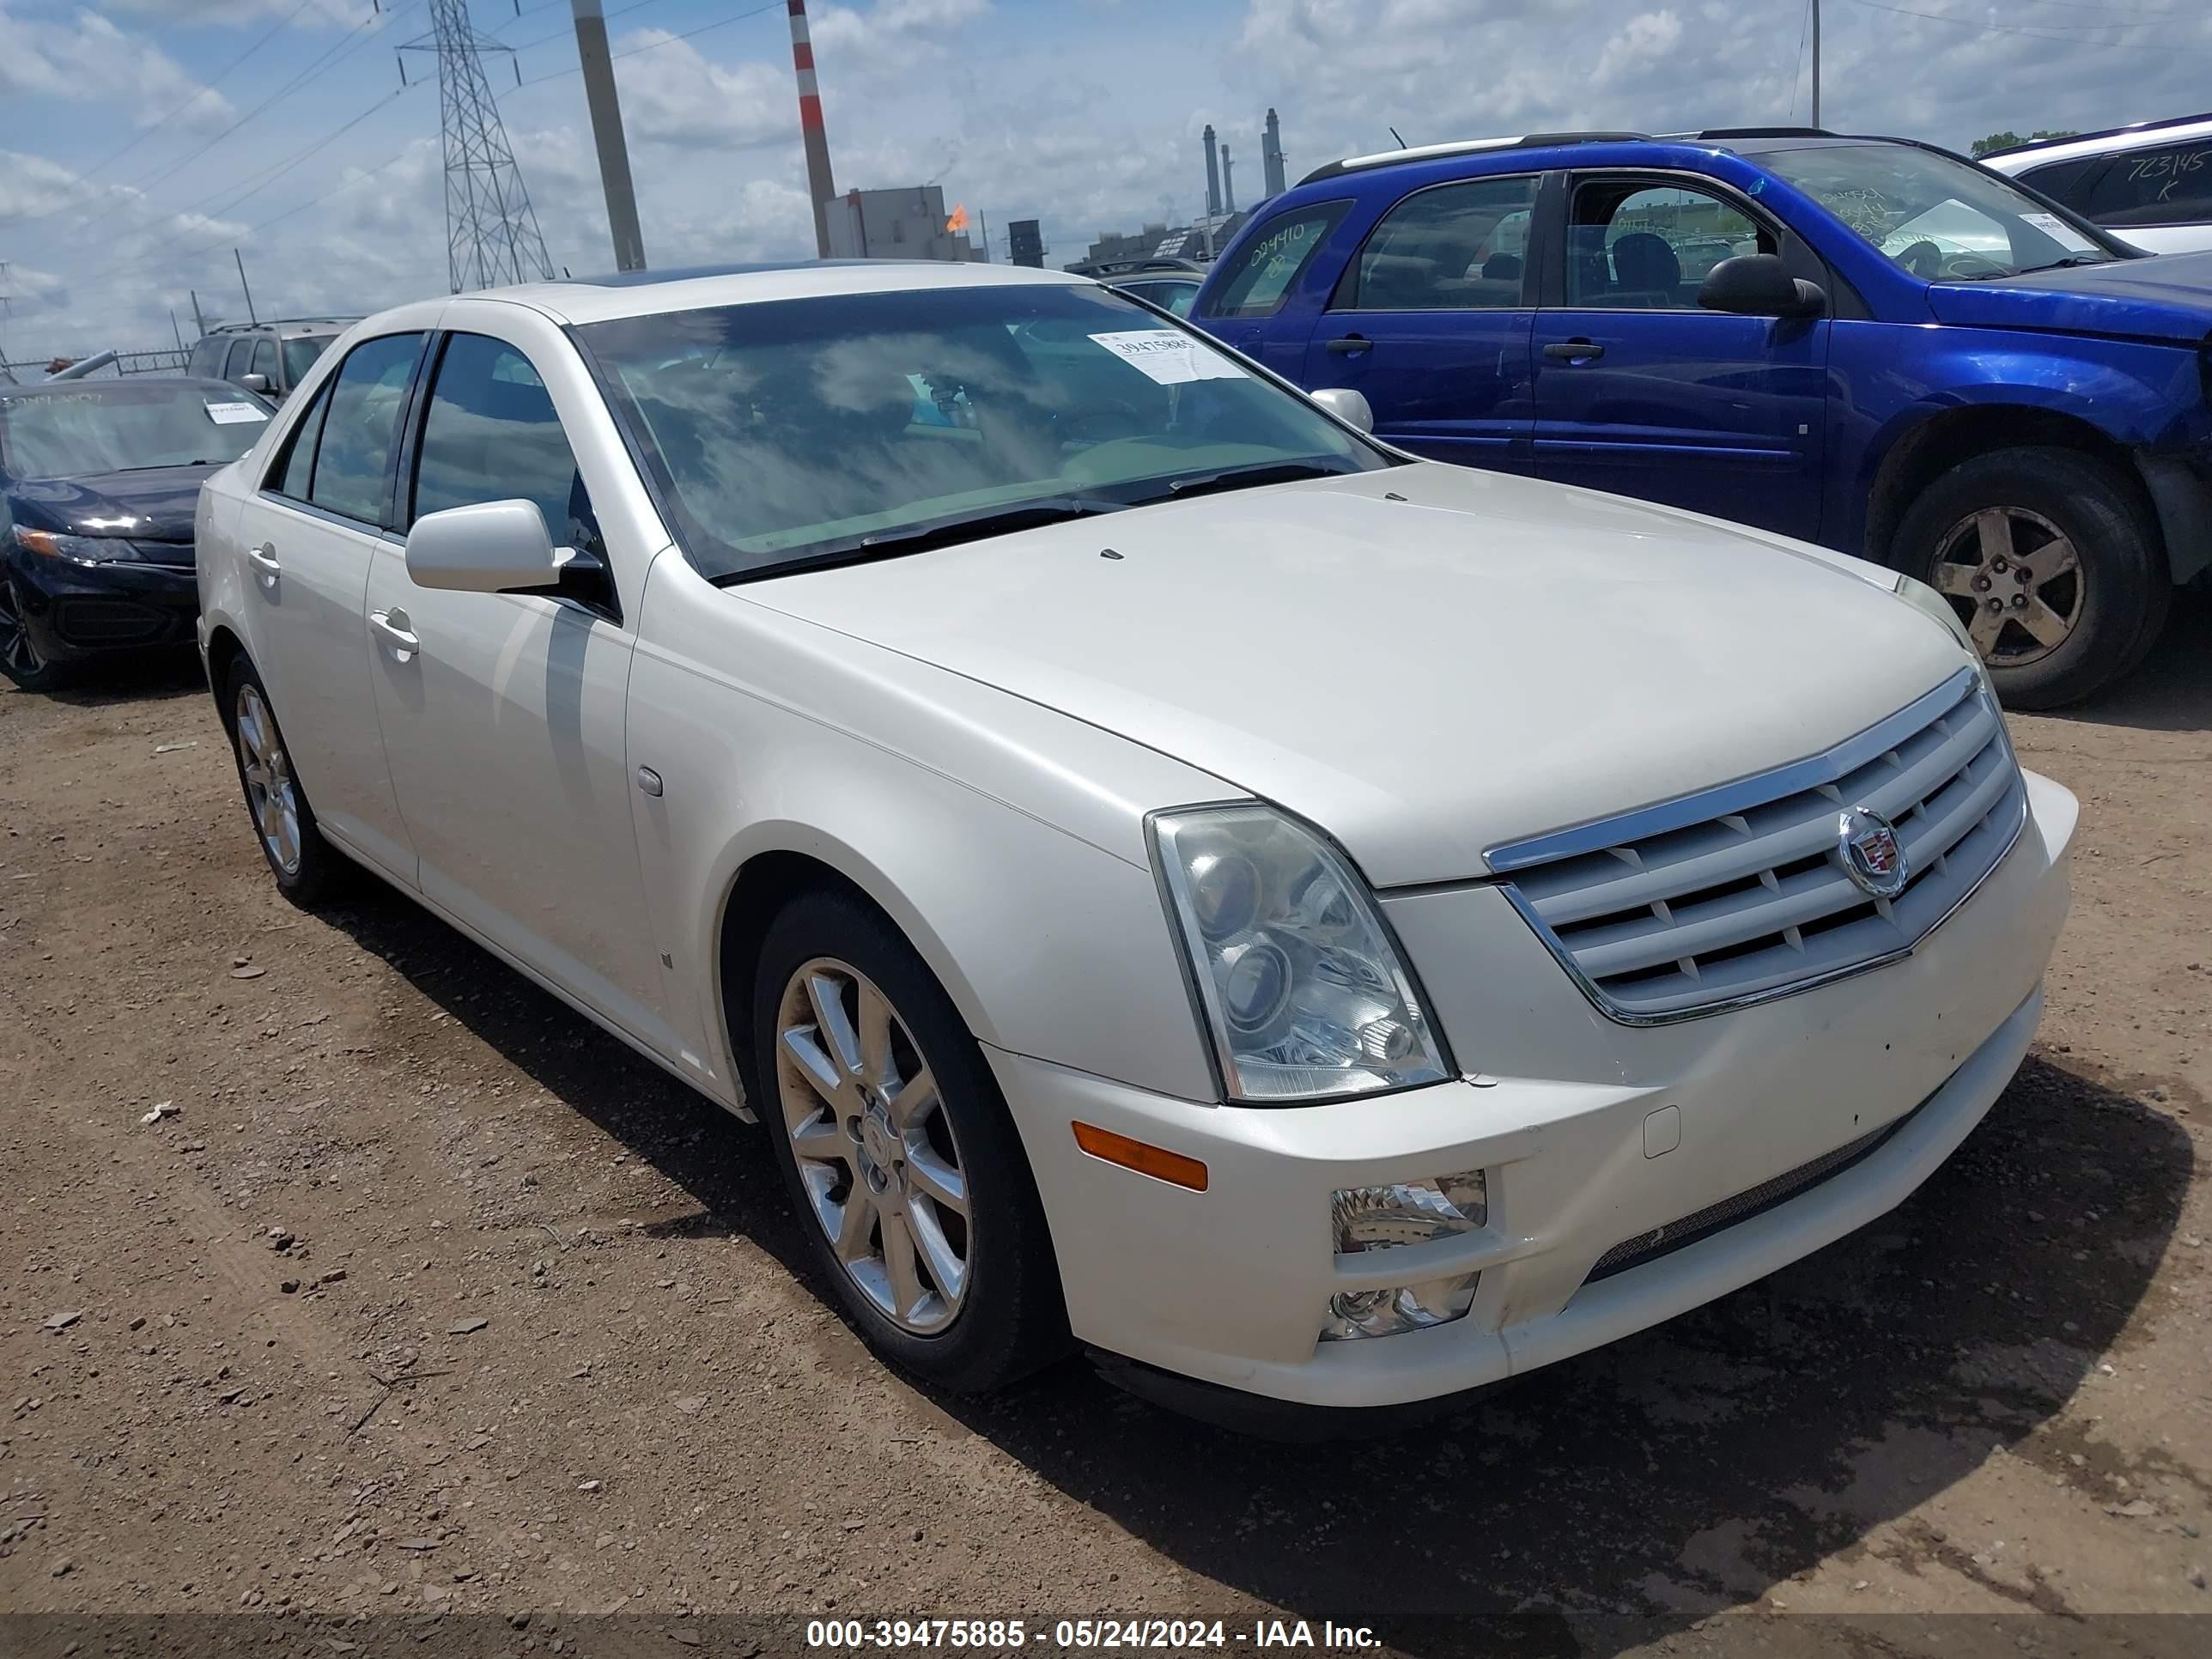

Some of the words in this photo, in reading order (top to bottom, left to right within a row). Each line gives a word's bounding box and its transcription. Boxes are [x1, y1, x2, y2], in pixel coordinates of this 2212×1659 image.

[2157, 178, 2179, 201] K
[1250, 223, 1304, 267] 024410
[1116, 339, 1195, 354] 39475885
